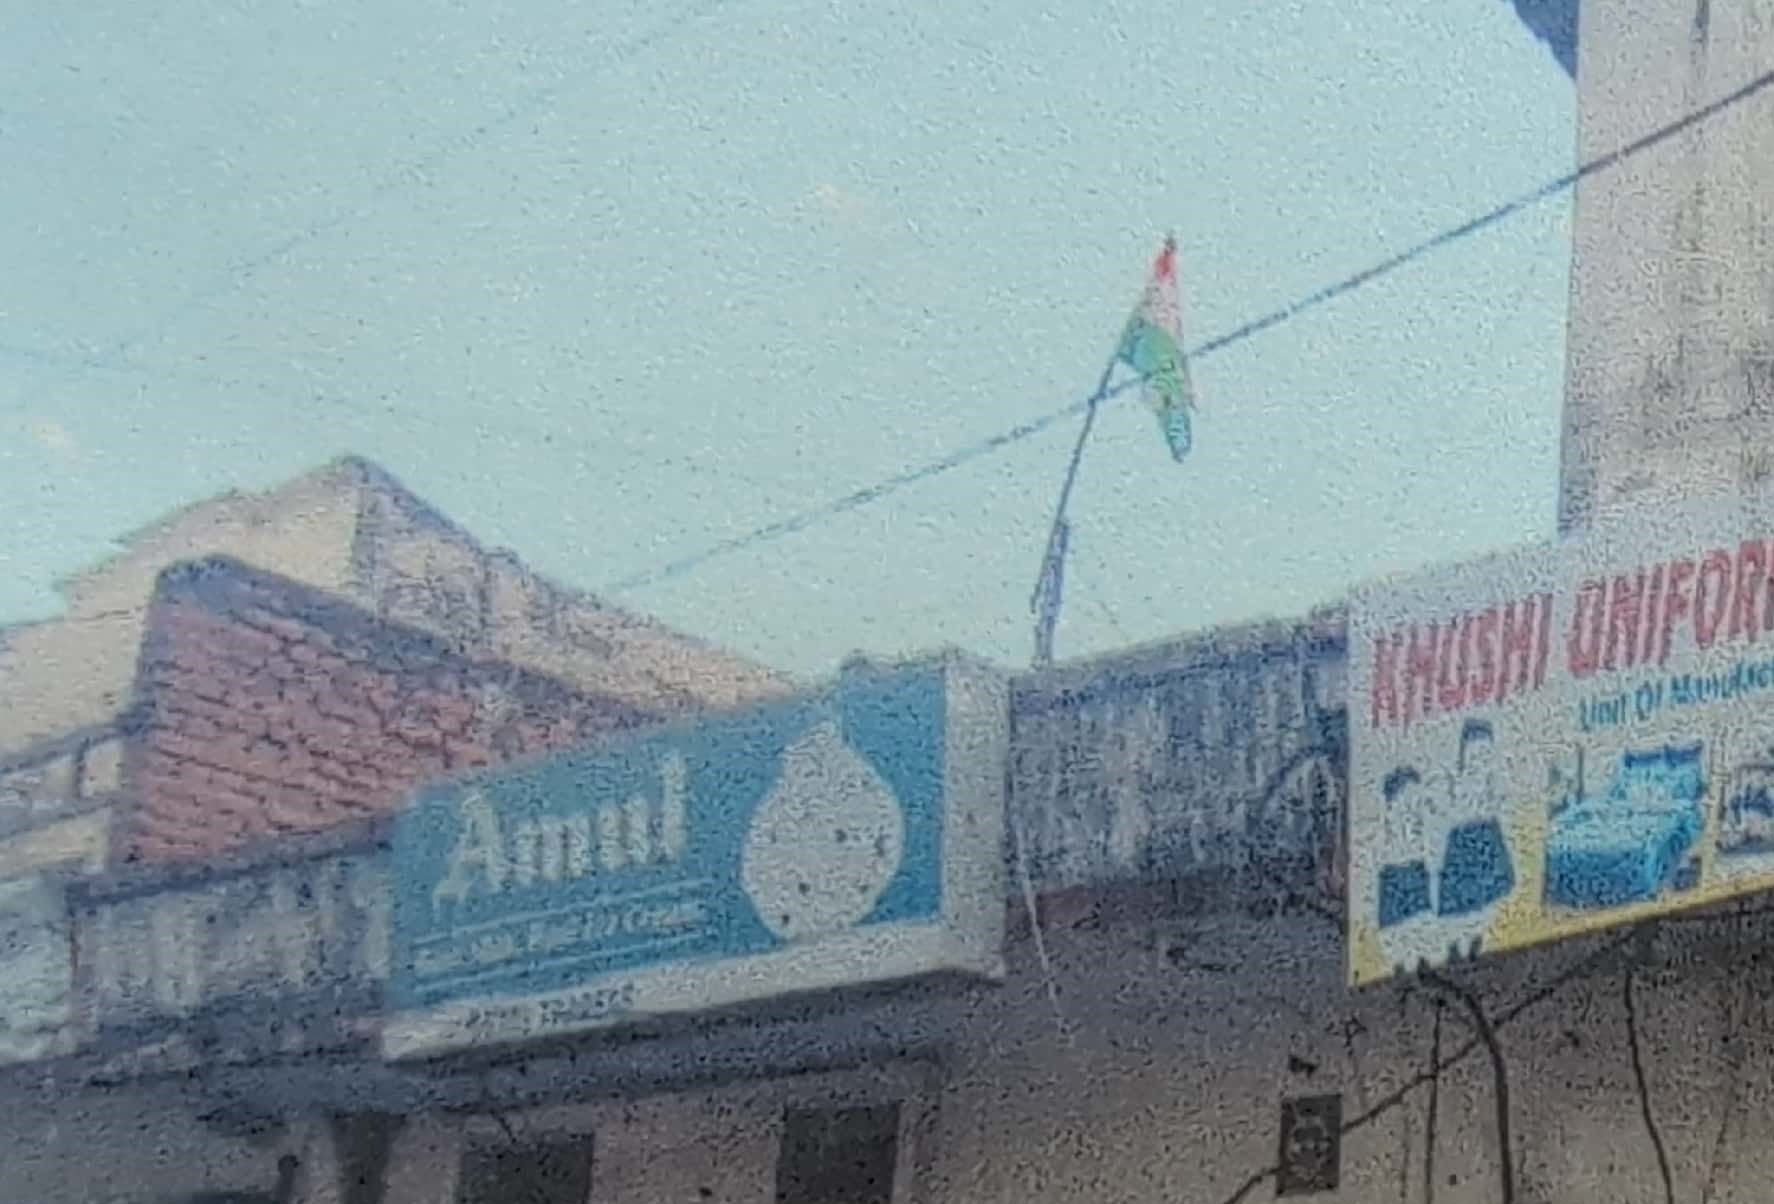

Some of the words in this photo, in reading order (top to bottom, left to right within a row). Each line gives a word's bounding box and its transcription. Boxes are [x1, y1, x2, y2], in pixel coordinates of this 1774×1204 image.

[1371, 591, 1554, 734] KHUSHI
[1578, 690, 1628, 732] Unit
[431, 750, 687, 924] Amul
